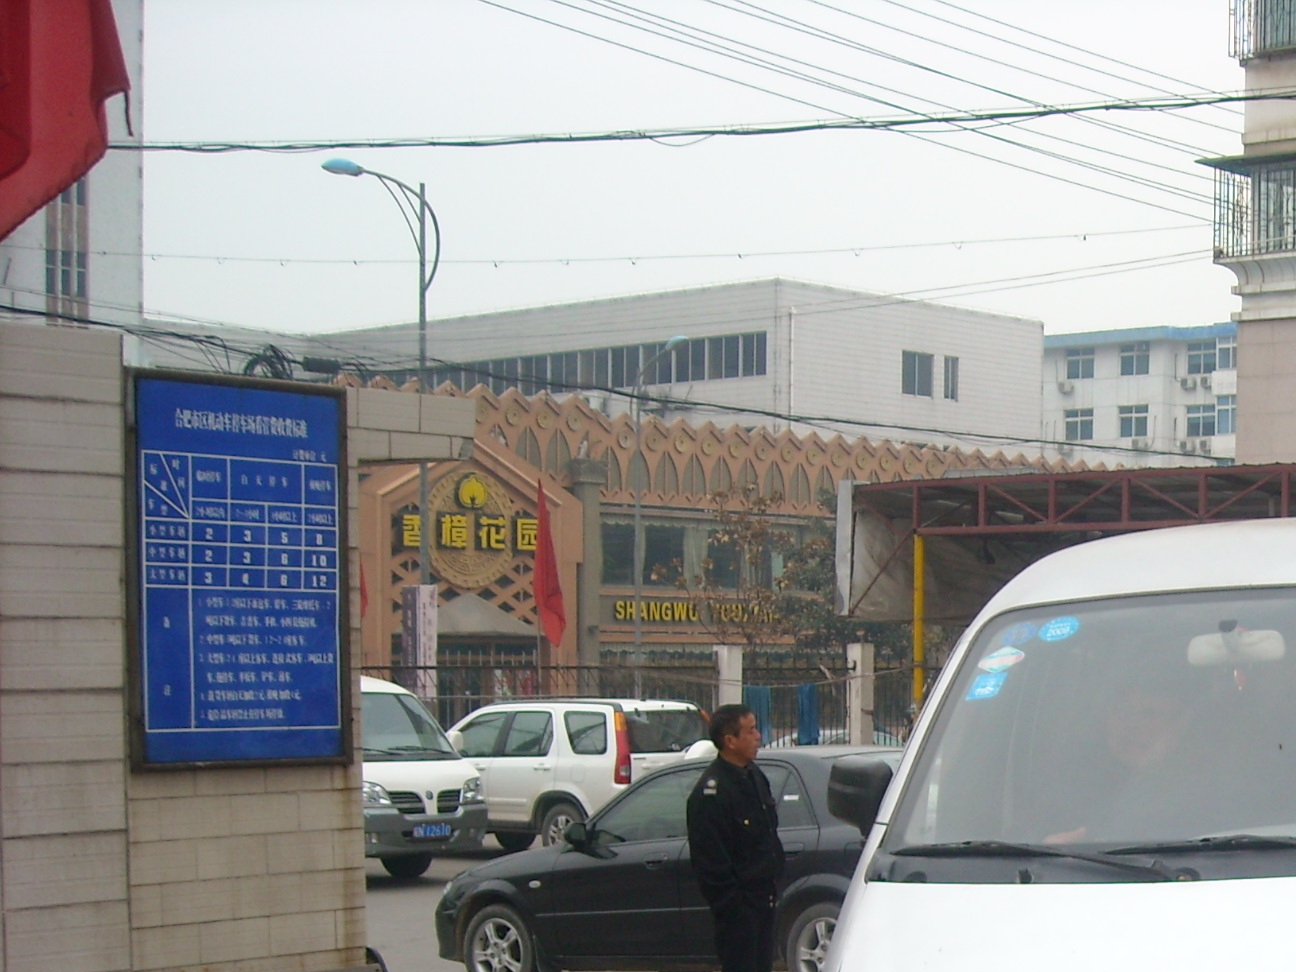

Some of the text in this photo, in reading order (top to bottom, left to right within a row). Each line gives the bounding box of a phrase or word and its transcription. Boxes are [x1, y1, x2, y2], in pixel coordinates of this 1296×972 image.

[403, 513, 540, 552] 香樟花园
[615, 599, 699, 622] SHANGWU
